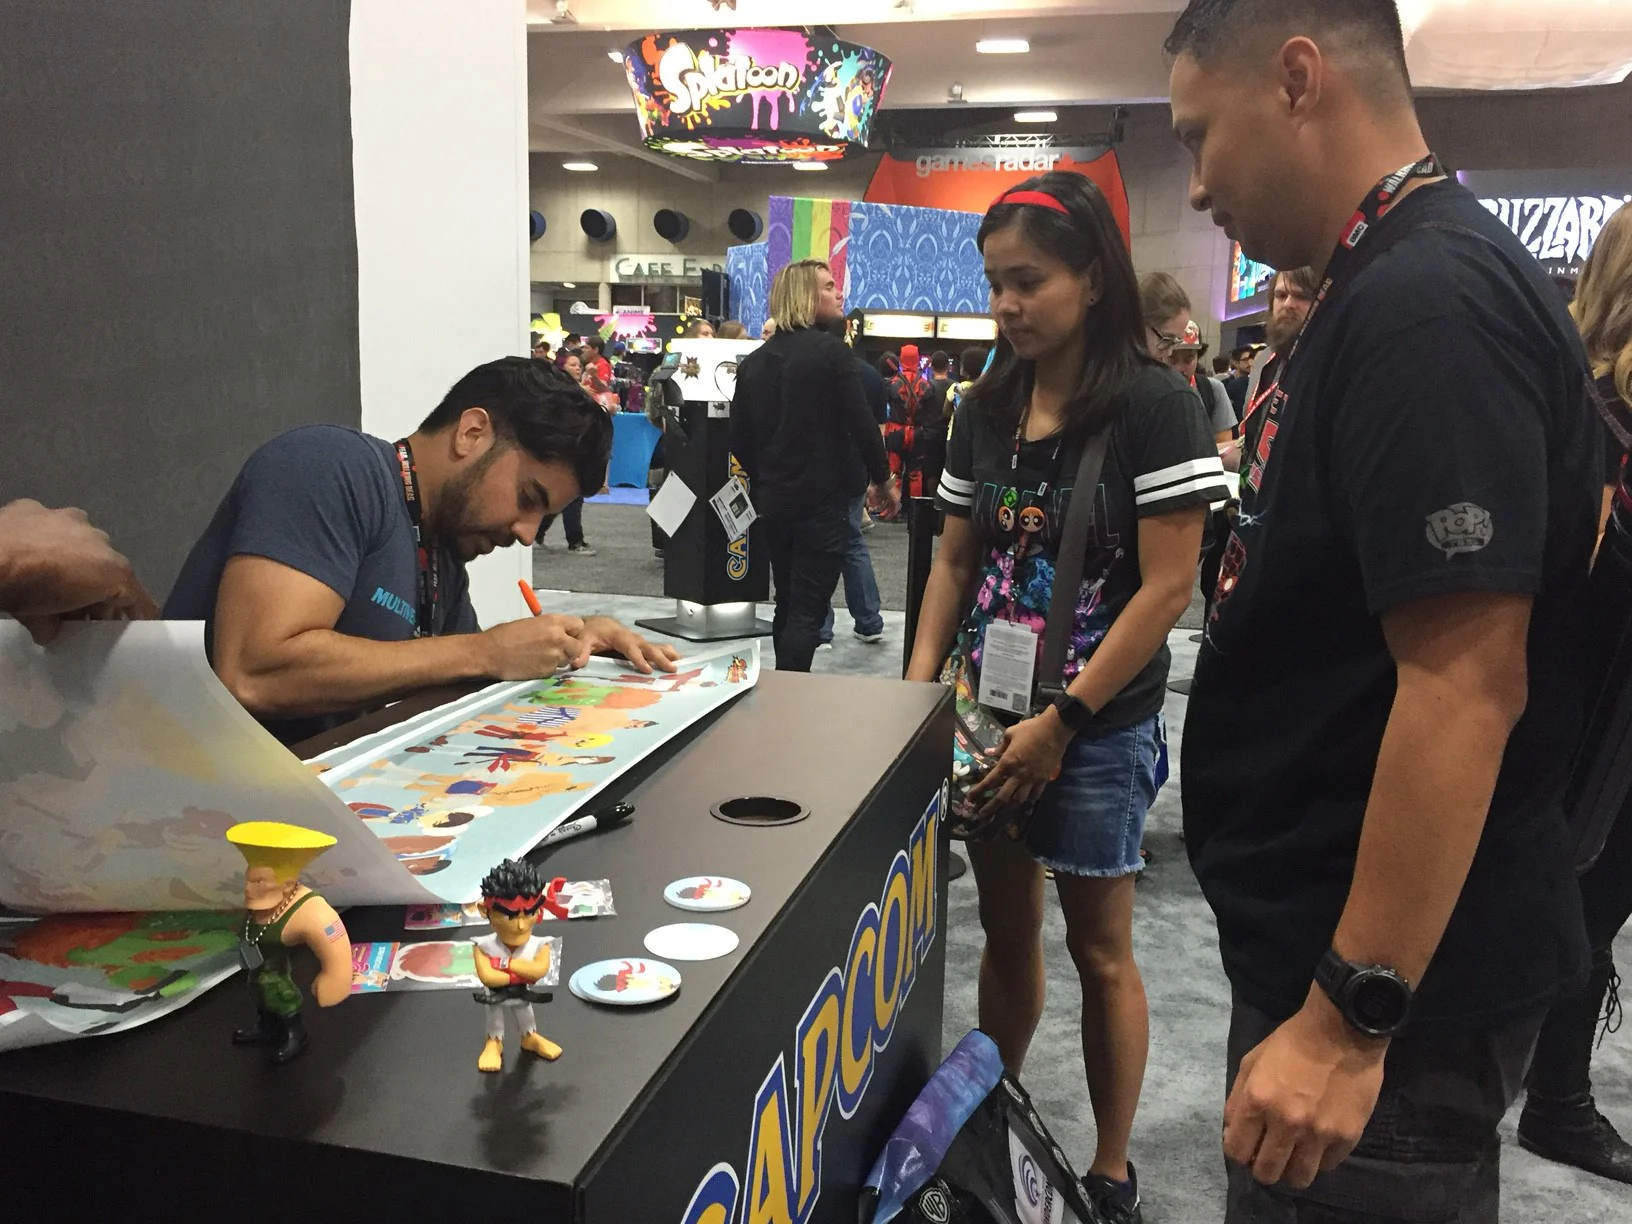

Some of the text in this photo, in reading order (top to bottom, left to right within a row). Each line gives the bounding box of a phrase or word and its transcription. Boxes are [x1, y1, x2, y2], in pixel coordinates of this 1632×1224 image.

[659, 42, 801, 114] Splatoon
[916, 148, 1060, 177] gamesradar
[681, 788, 941, 1224] APCOM
